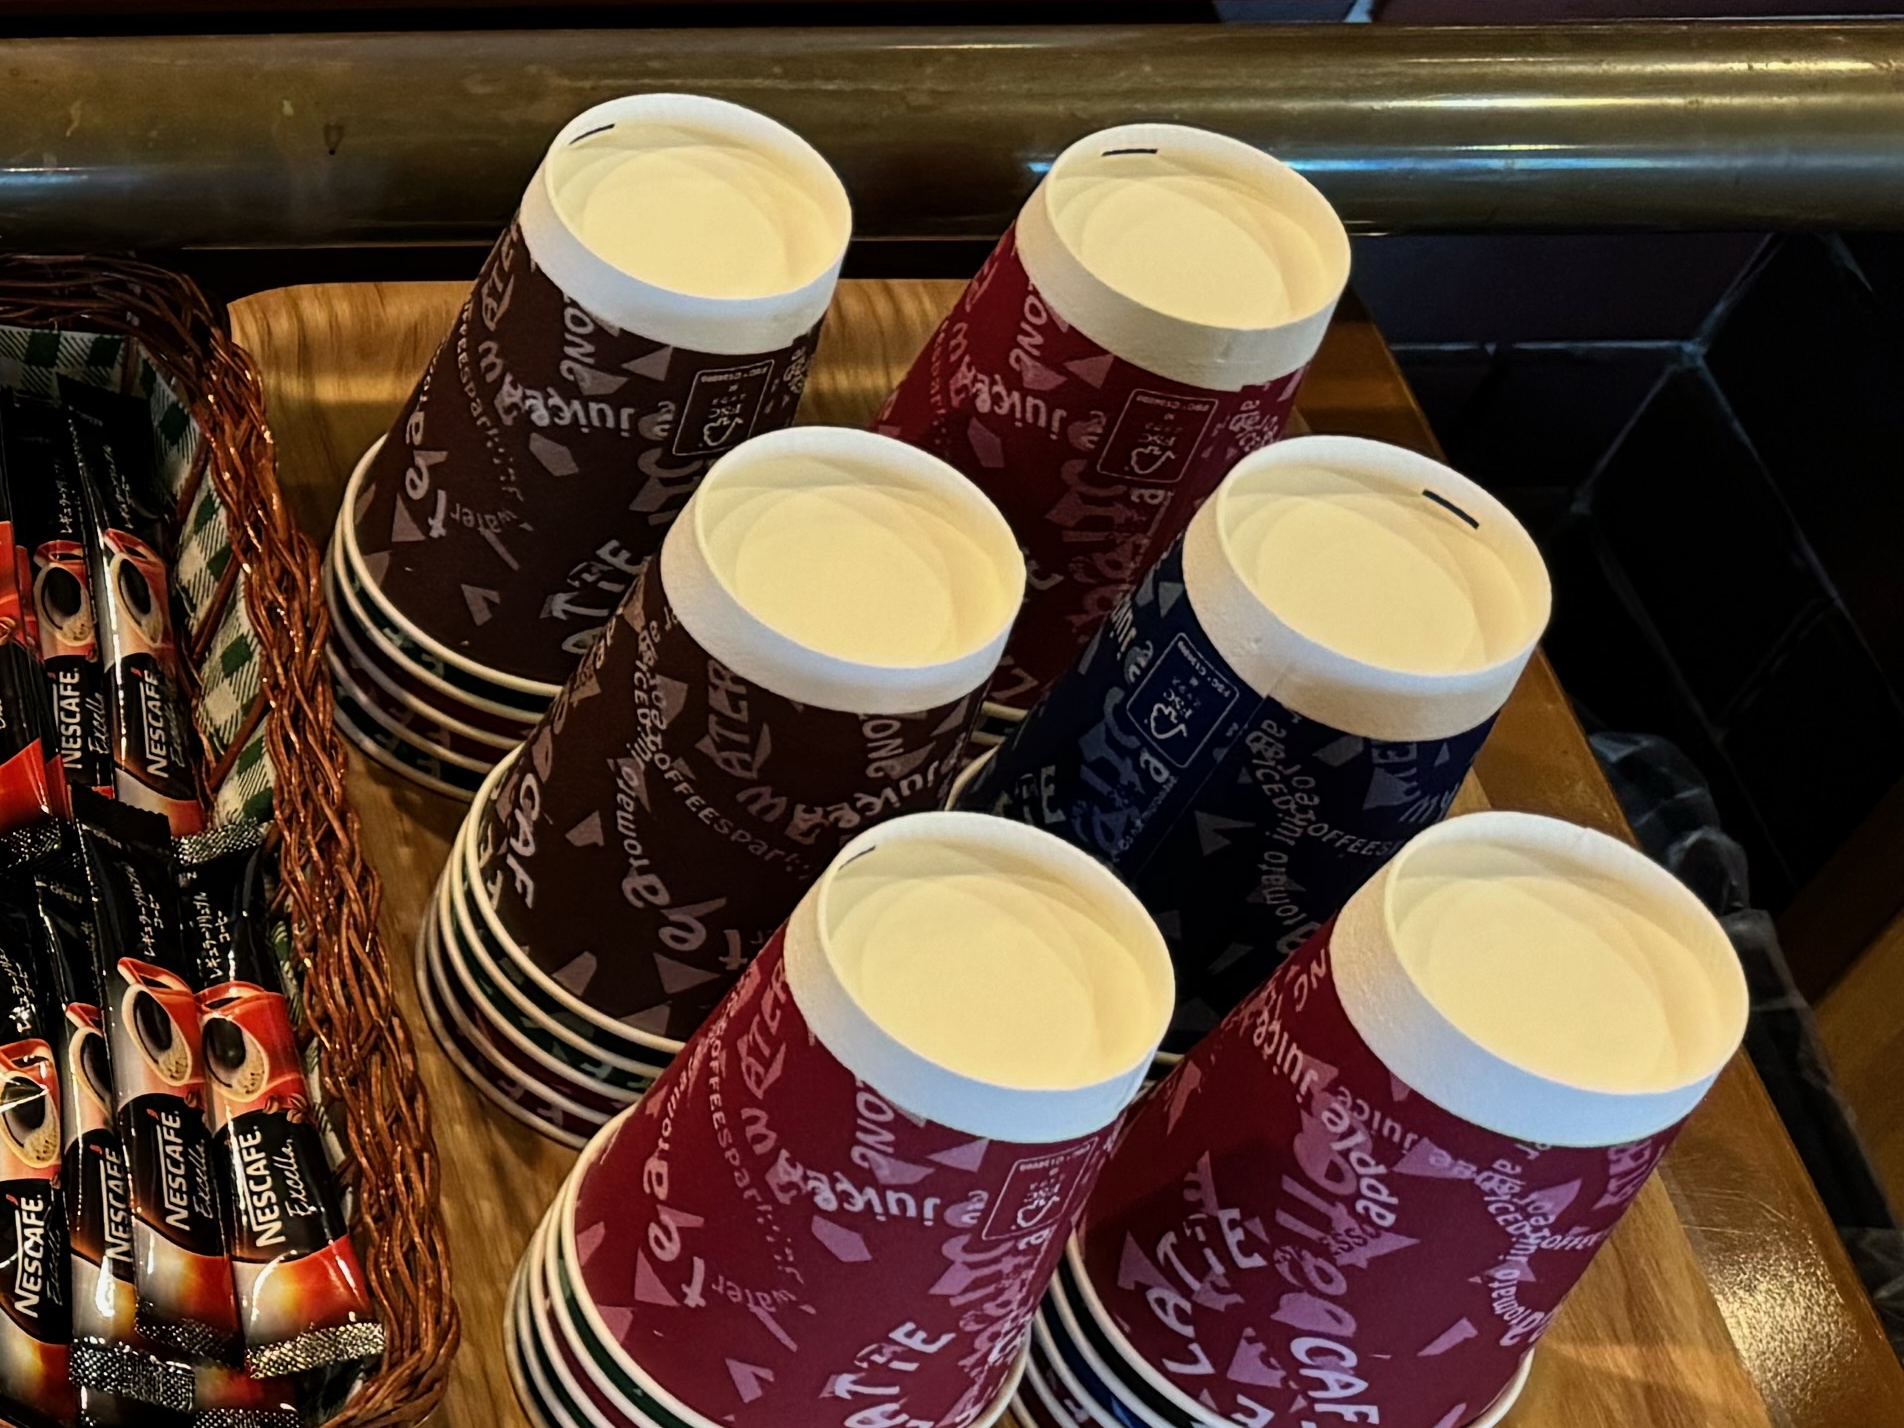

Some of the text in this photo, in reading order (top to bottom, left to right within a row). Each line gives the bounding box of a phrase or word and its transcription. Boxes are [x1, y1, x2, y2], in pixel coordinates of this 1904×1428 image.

[1338, 1086, 1418, 1154] juice
[285, 1138, 317, 1218] Excella
[1321, 1101, 1399, 1227] apple
